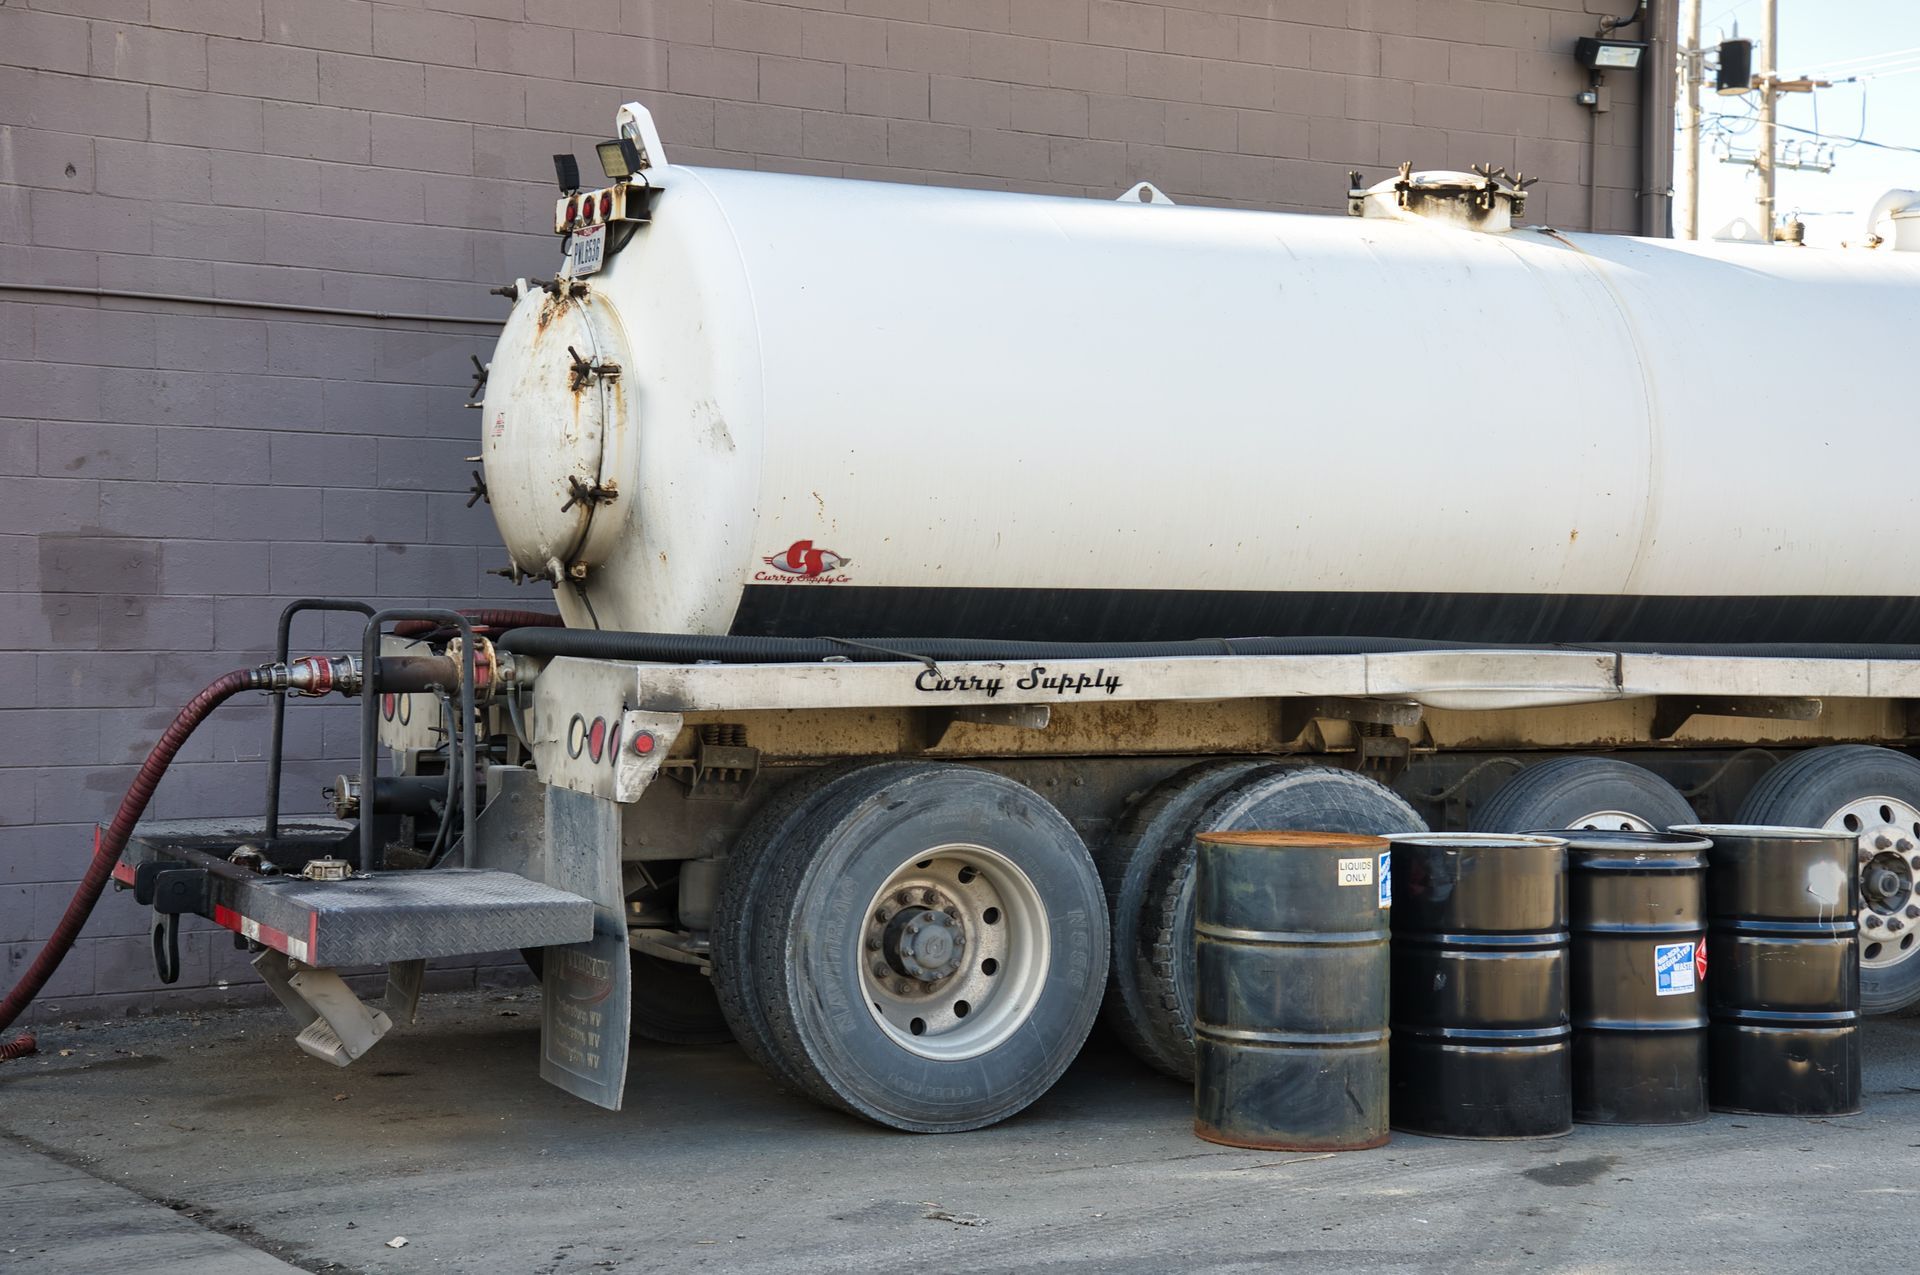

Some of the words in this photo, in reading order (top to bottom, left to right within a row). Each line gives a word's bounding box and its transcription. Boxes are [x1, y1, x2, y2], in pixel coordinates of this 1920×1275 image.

[754, 571, 799, 584] Curry
[914, 669, 1004, 697] Curry
[1016, 666, 1123, 695] Supply
[1339, 861, 1372, 871] LIQUIDS
[1345, 873, 1367, 883] ONLY
[1657, 945, 1692, 973] REGULATED
[1673, 962, 1694, 971] WASTE
